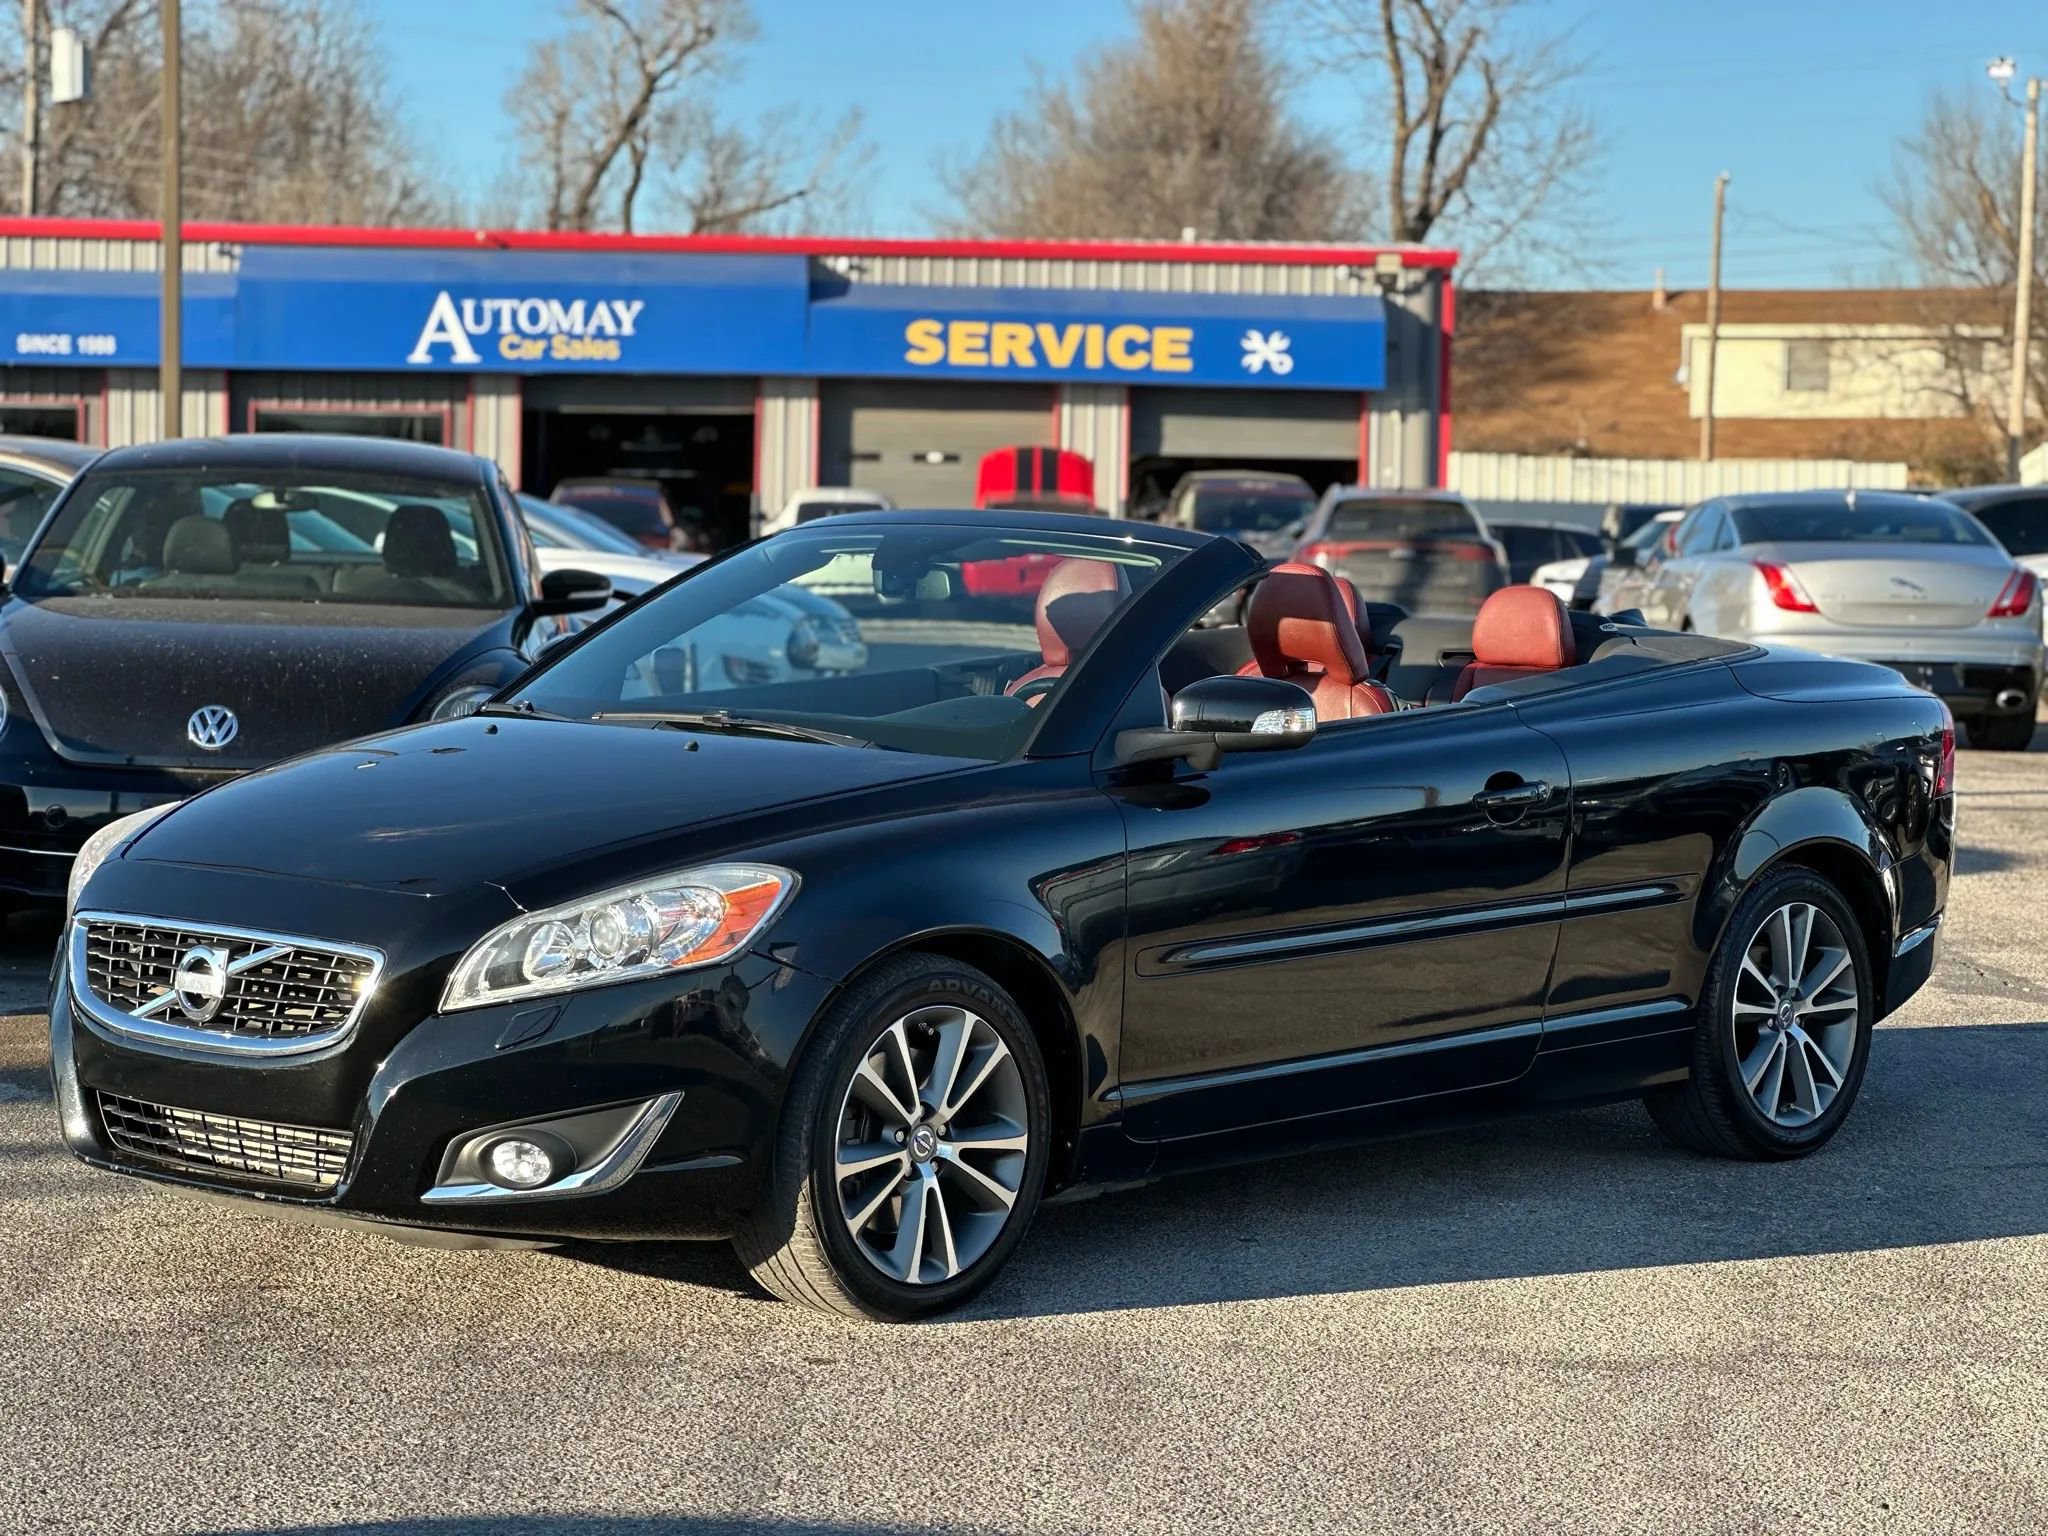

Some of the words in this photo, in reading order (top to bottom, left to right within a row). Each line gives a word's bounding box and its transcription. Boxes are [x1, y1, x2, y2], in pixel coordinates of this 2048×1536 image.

[16, 333, 72, 355] SINCE
[406, 290, 645, 364] AUTOMAY
[904, 319, 1194, 372] SERVICE
[498, 334, 547, 360] Car
[550, 334, 621, 361] Sales
